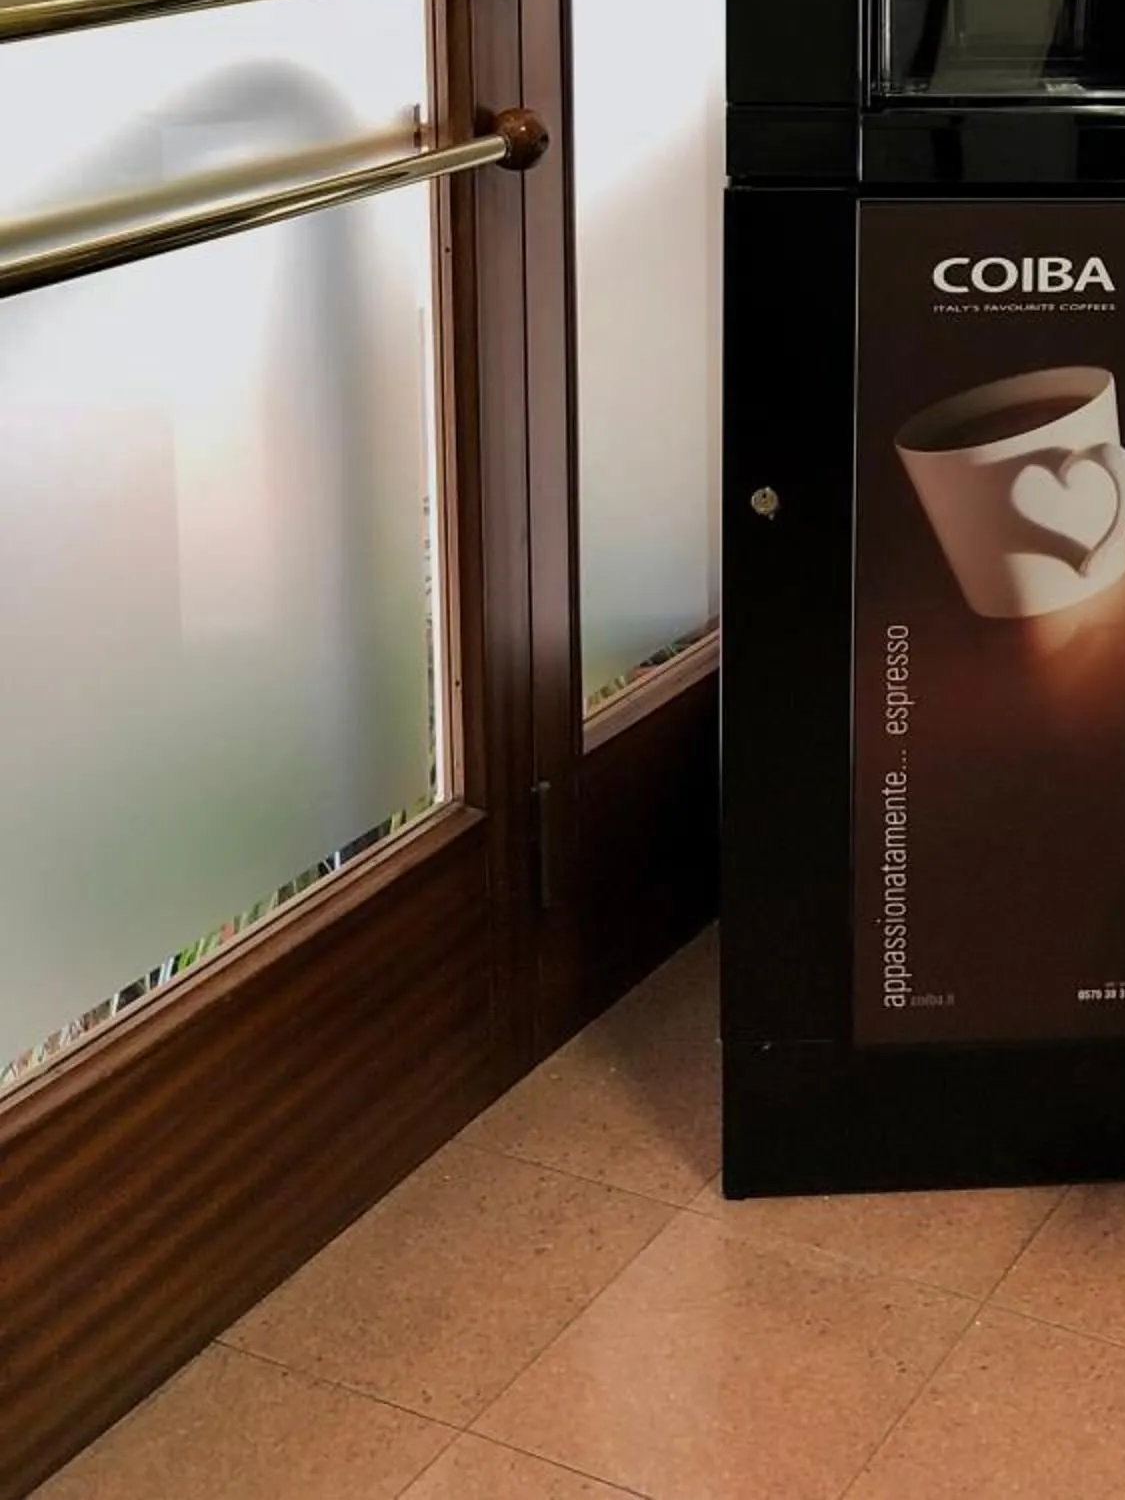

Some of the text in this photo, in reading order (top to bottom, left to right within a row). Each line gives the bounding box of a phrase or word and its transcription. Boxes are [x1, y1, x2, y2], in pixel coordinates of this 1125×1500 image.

[932, 256, 1116, 294] COIBA
[933, 304, 980, 313] ITALY'S
[1058, 303, 1116, 312] COFFEES
[877, 625, 916, 1008] appassionatamente... espresso
